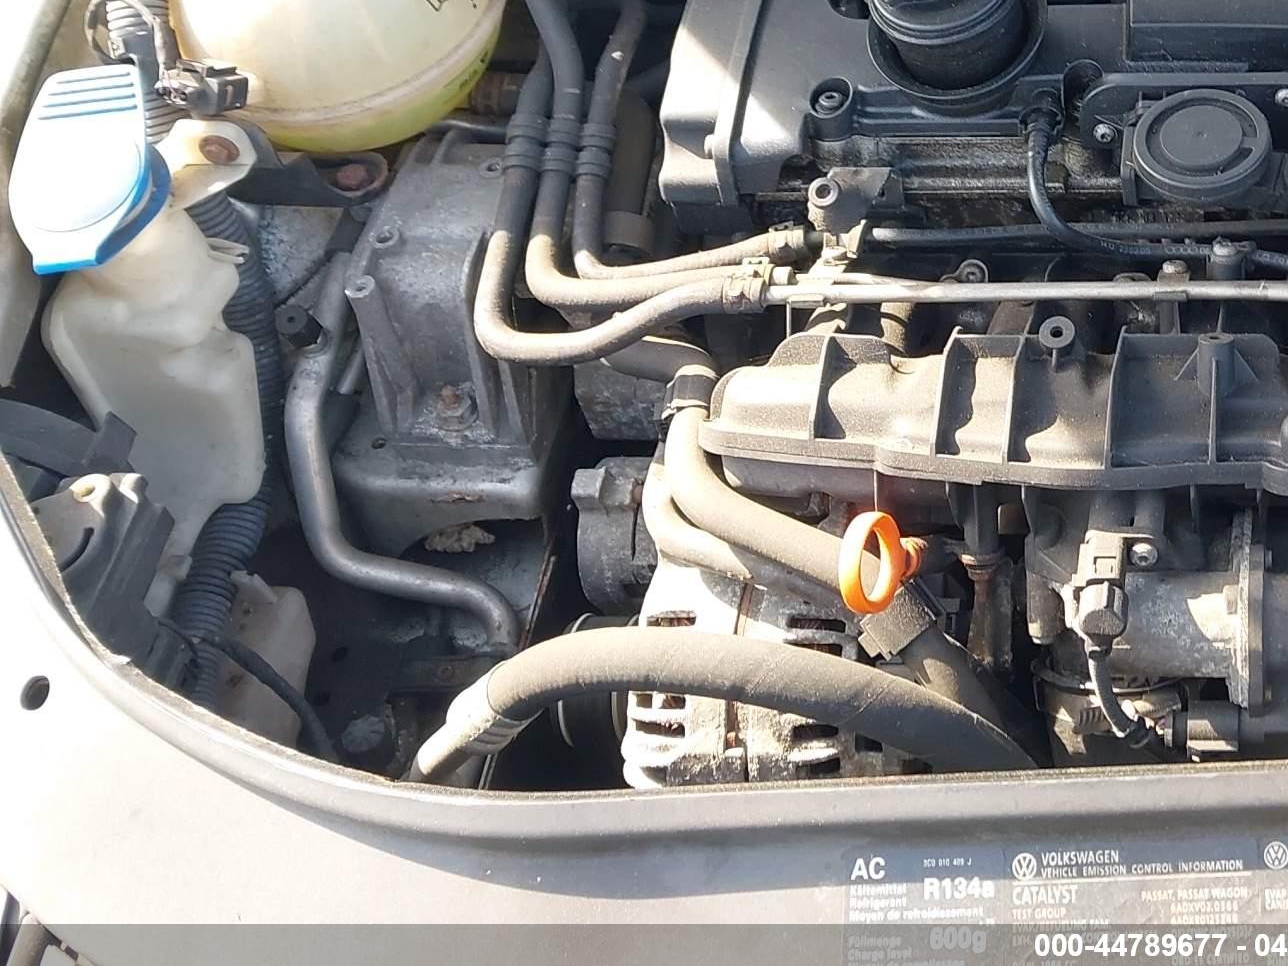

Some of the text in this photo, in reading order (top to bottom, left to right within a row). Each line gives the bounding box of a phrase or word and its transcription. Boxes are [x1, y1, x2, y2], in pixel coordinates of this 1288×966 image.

[1041, 850, 1119, 867] VOLKSWAGEN
[850, 856, 886, 881] AC
[1041, 859, 1244, 878] VEHICLE EMISSION CONTROL INFORMATION
[922, 876, 995, 901] R134a
[1011, 885, 1078, 906] CATALYST
[1264, 888, 1287, 899] EVAP
[1011, 906, 1067, 921] TEST GROUP
